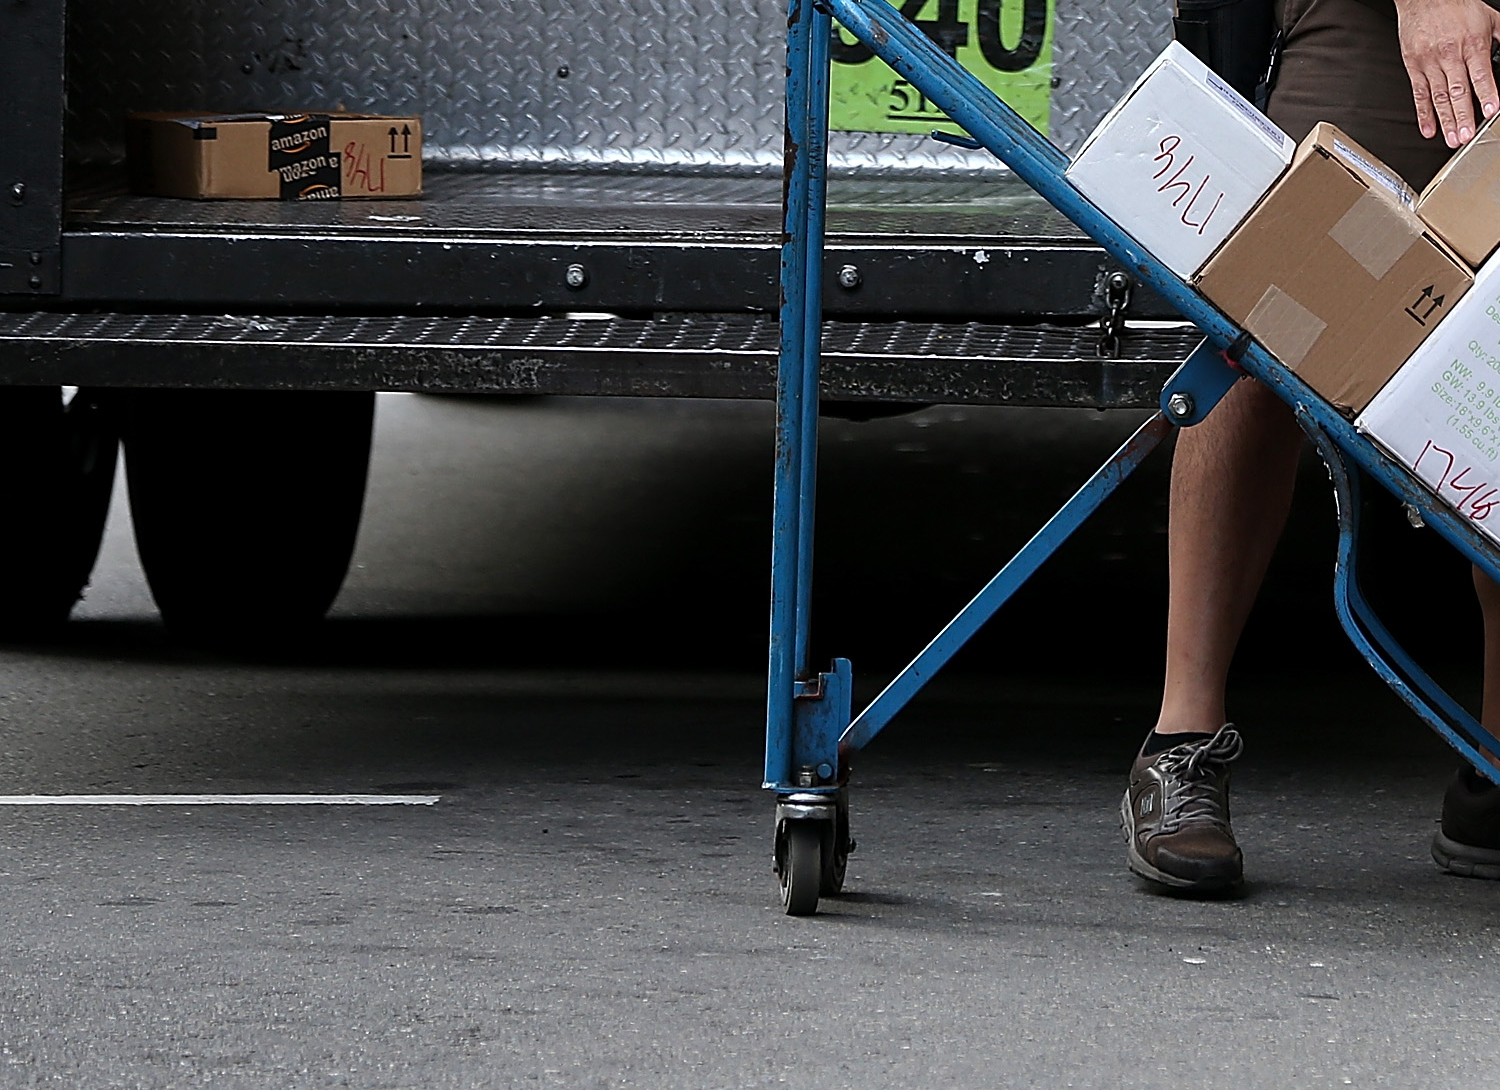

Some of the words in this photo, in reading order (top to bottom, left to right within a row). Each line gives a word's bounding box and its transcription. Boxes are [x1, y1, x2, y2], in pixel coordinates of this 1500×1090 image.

[271, 126, 328, 151] amazon
[1468, 340, 1488, 361] Qty:
[1451, 358, 1472, 379] NW:
[1477, 381, 1495, 399] 9.9
[1442, 370, 1464, 390] GW:
[1465, 389, 1485, 410] 13.9
[1484, 407, 1500, 424] lbs
